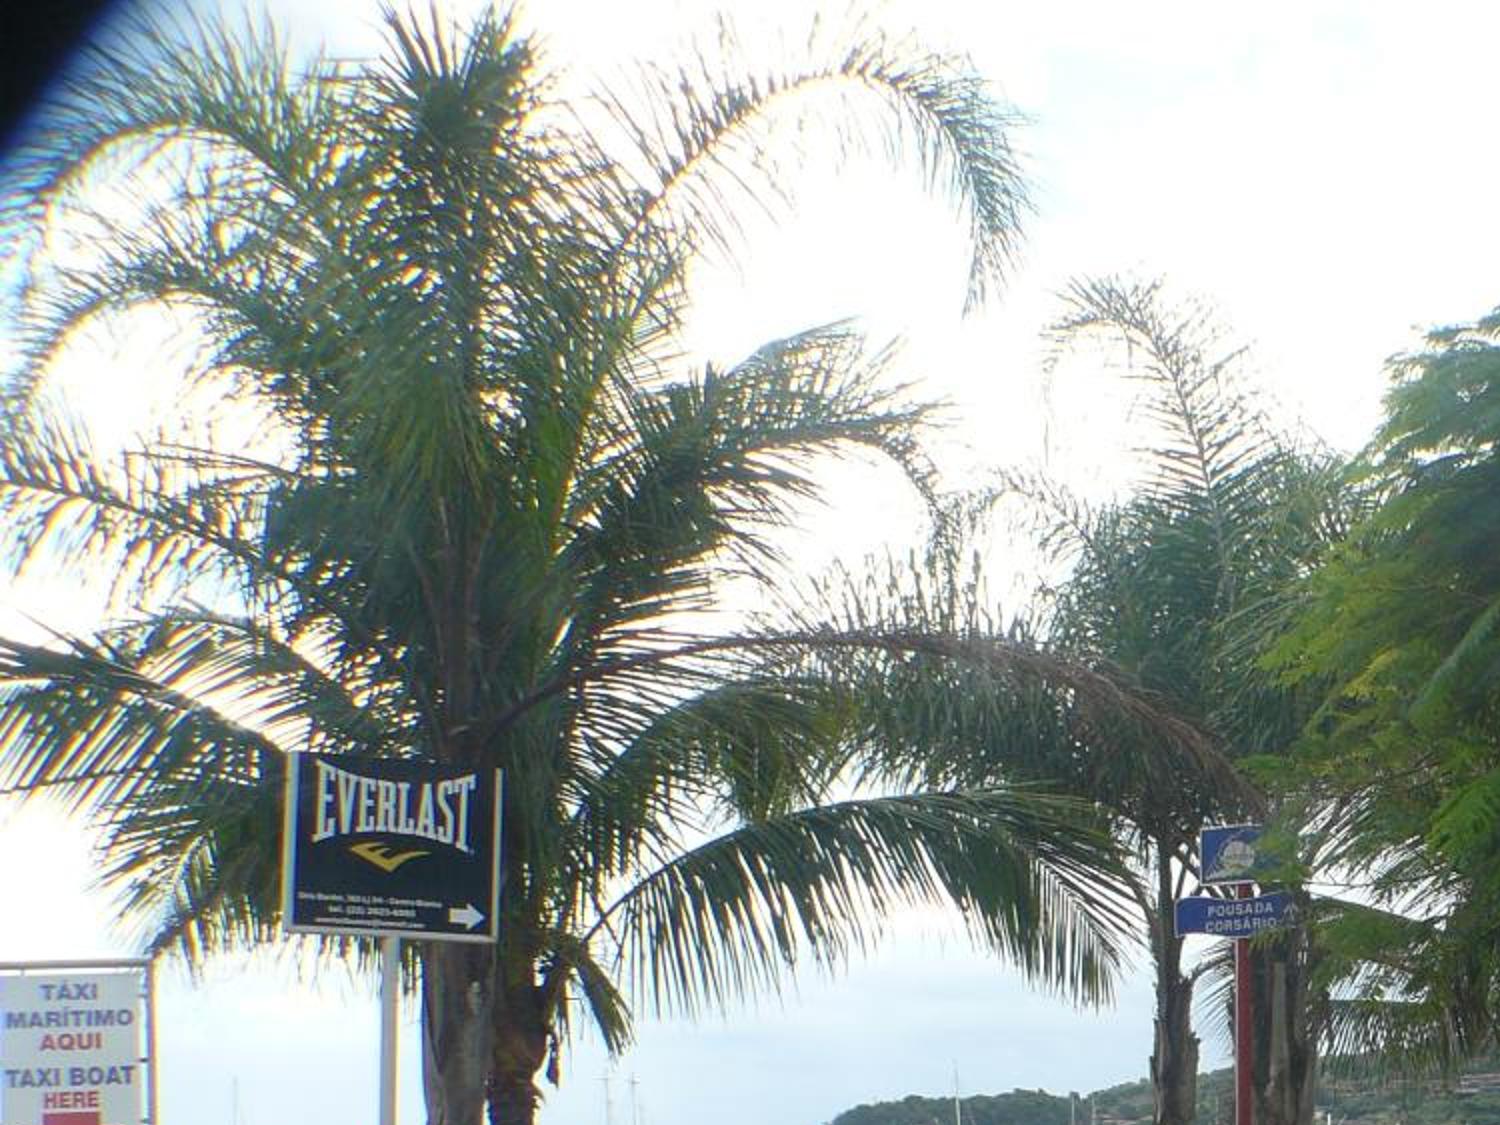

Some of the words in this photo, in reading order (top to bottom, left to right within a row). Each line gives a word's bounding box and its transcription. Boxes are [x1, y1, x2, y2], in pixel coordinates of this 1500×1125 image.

[312, 758, 477, 854] EVERLAST
[1207, 901, 1274, 917] POUSADA
[1205, 916, 1277, 933] CORSÁRIO
[40, 980, 97, 1000] TÁXI
[6, 1007, 133, 1028] MARÍTIMO
[40, 1033, 102, 1051] AQUI
[5, 1068, 60, 1088] TAXI
[69, 1066, 135, 1086] BOAT
[44, 1092, 99, 1109] HERE
